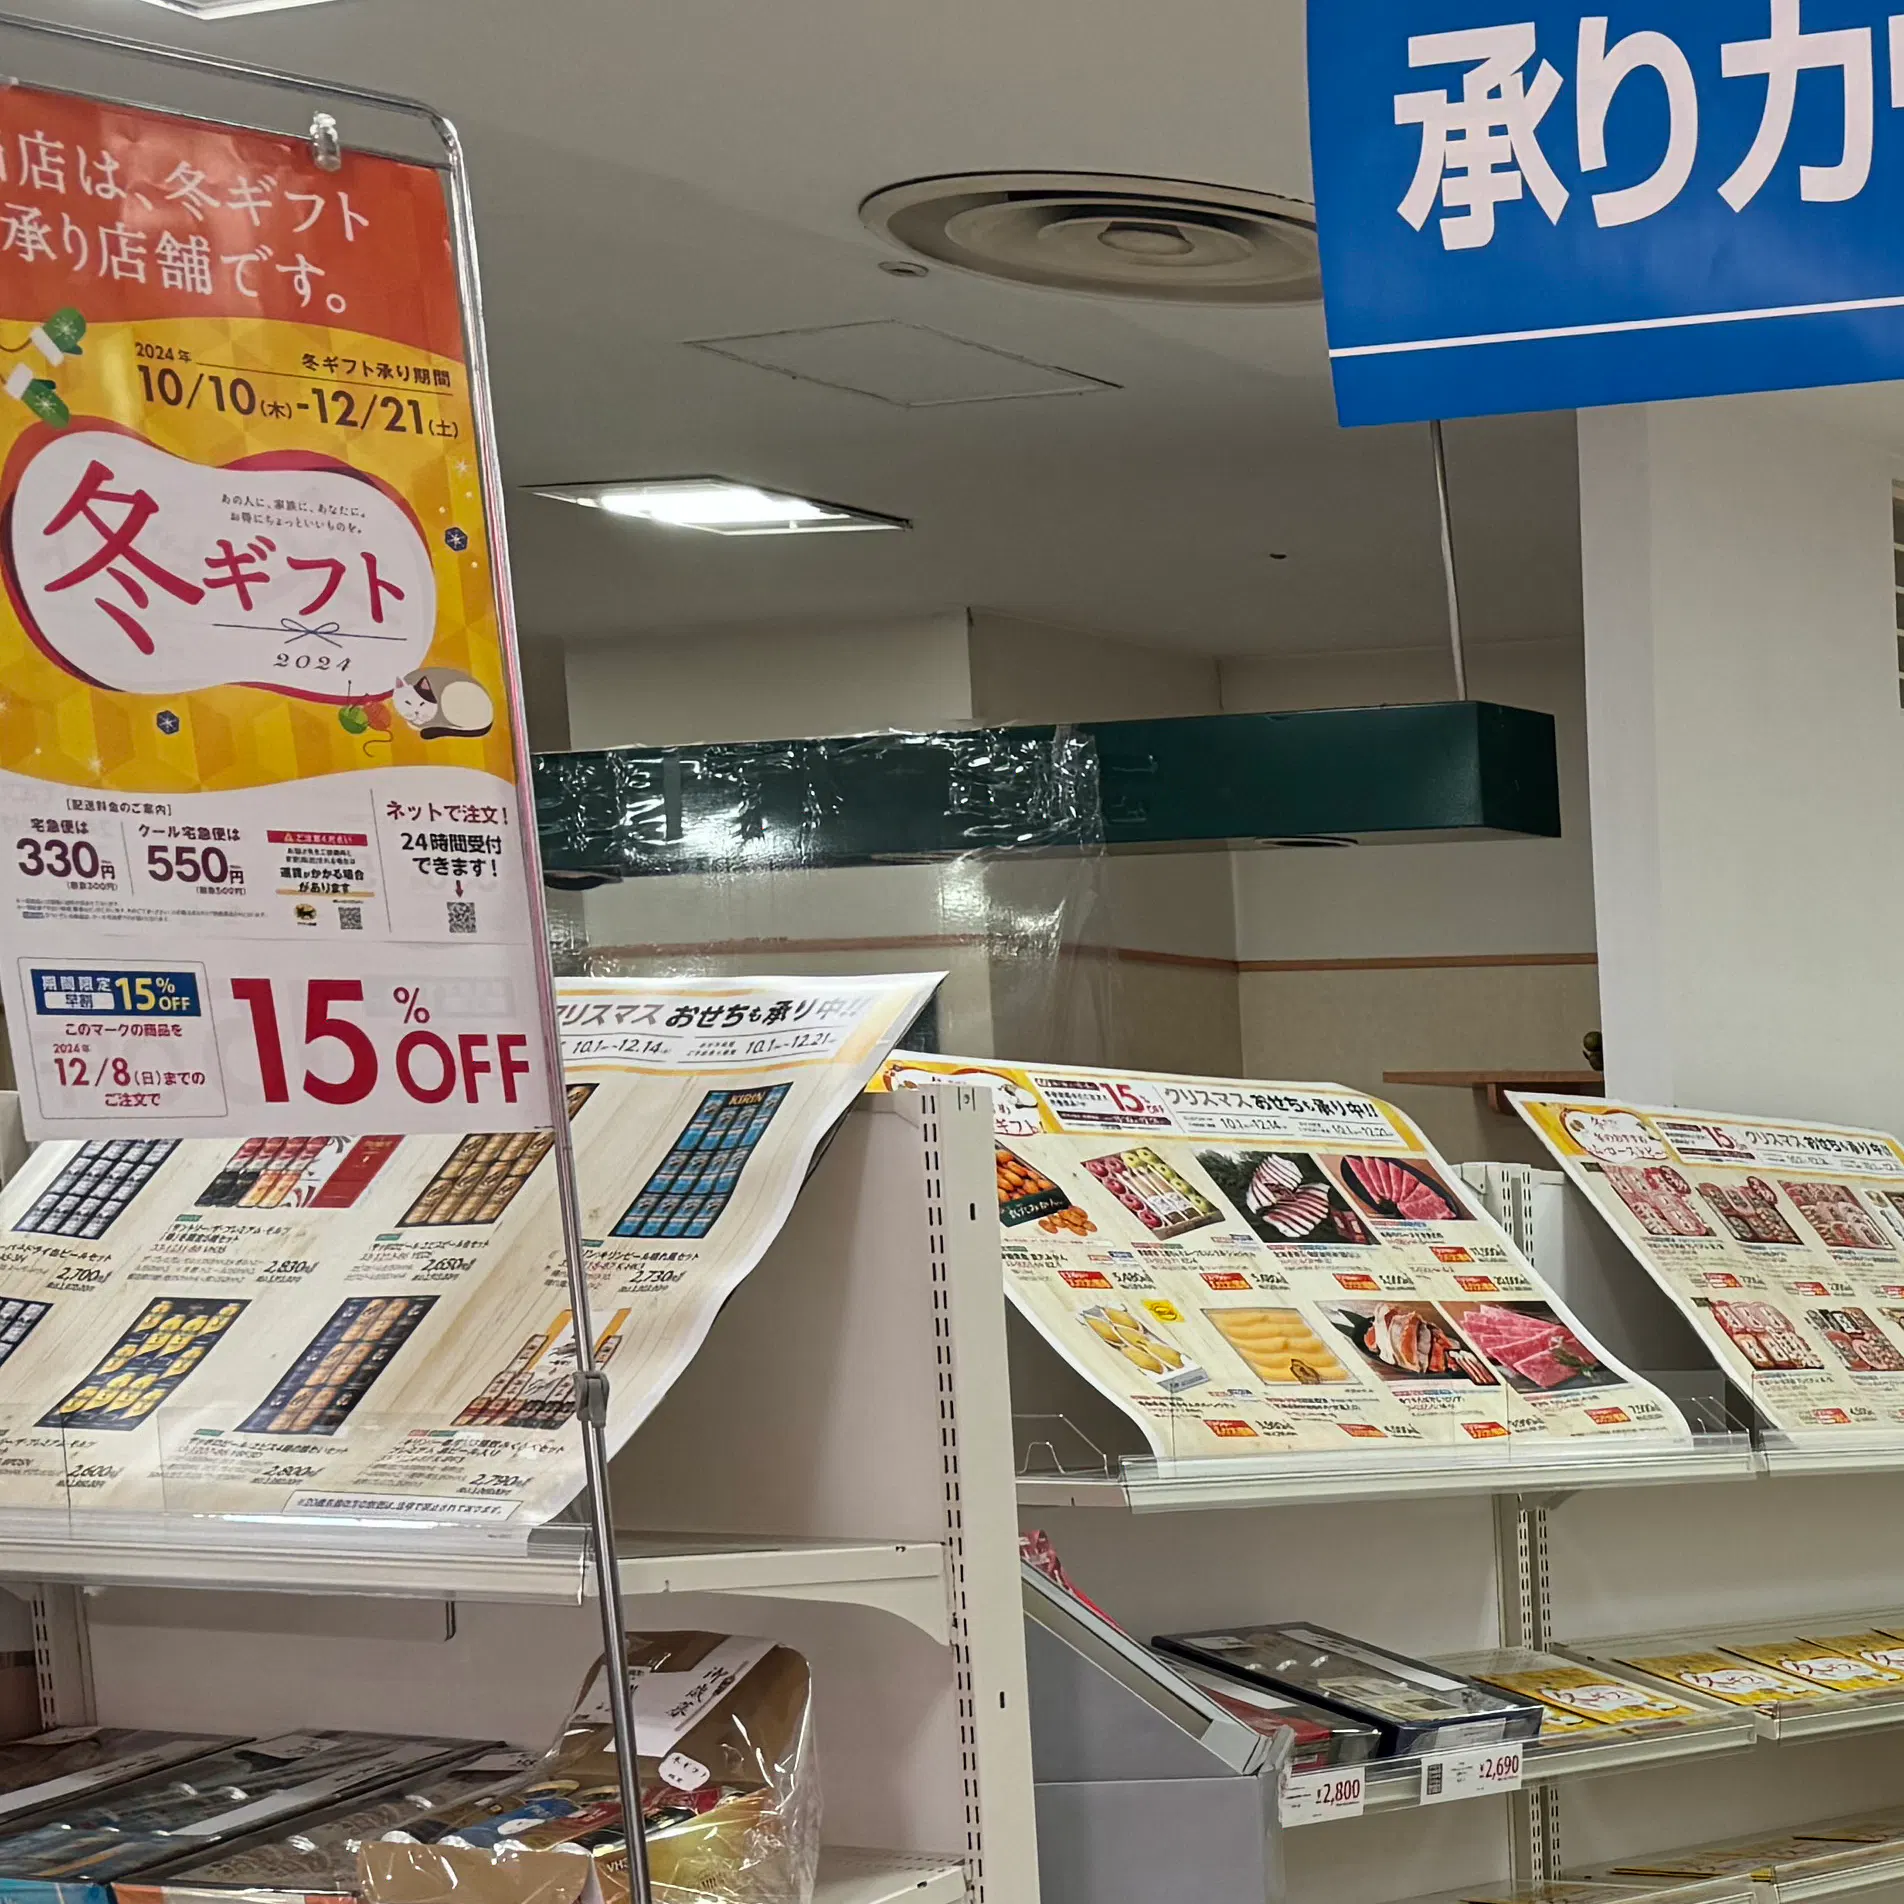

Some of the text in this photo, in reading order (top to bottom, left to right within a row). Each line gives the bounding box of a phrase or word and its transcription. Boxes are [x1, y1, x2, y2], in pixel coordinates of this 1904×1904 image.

[0, 130, 370, 243] 店は、冬ギフト
[0, 205, 347, 314] 承り店舗です。
[135, 341, 193, 364] 2024年
[301, 353, 451, 388] 冬ギフト承り期間
[43, 458, 406, 656] 冬ギフト
[272, 651, 352, 673] 2024
[30, 818, 89, 836] 宅急便は
[138, 822, 241, 844] クール宅急便は
[401, 832, 502, 854] 24時間受付
[15, 838, 116, 881] 330円
[147, 844, 245, 886] 550円
[41, 975, 112, 992] 期間限定
[114, 977, 155, 1011] 15
[158, 995, 190, 1012] OFF
[64, 1023, 183, 1039] このマークの商品を
[232, 979, 379, 1105] 15
[396, 1030, 530, 1103] OFF
[104, 1091, 161, 1107] ご注文で
[728, 1092, 766, 1107] KIRIN
[1099, 1083, 1146, 1113] 15
[1164, 1087, 1251, 1109] クリスマス
